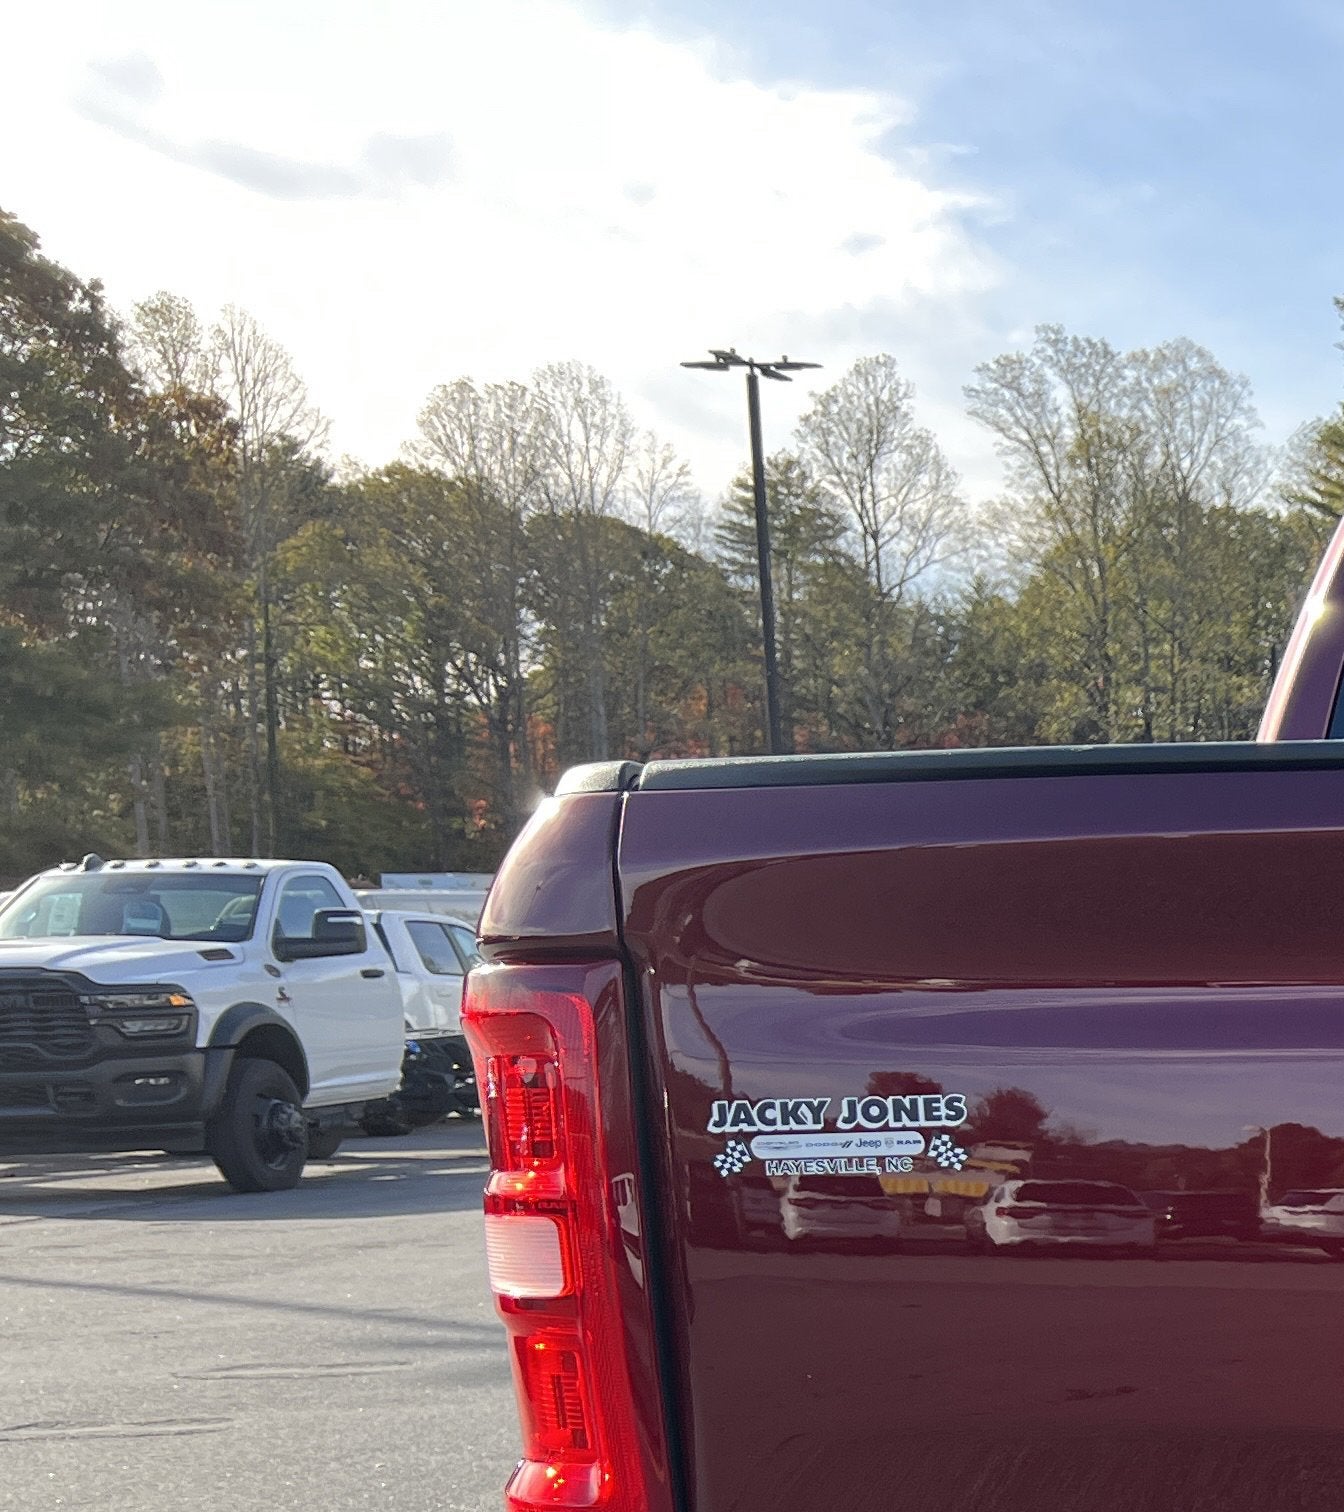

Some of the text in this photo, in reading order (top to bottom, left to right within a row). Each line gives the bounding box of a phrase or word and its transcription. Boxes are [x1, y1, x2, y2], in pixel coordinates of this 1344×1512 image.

[708, 1094, 967, 1132] JACKY JONES
[855, 1138, 882, 1149] Jeep
[766, 1157, 914, 1175] HAYESVILLE, NC
